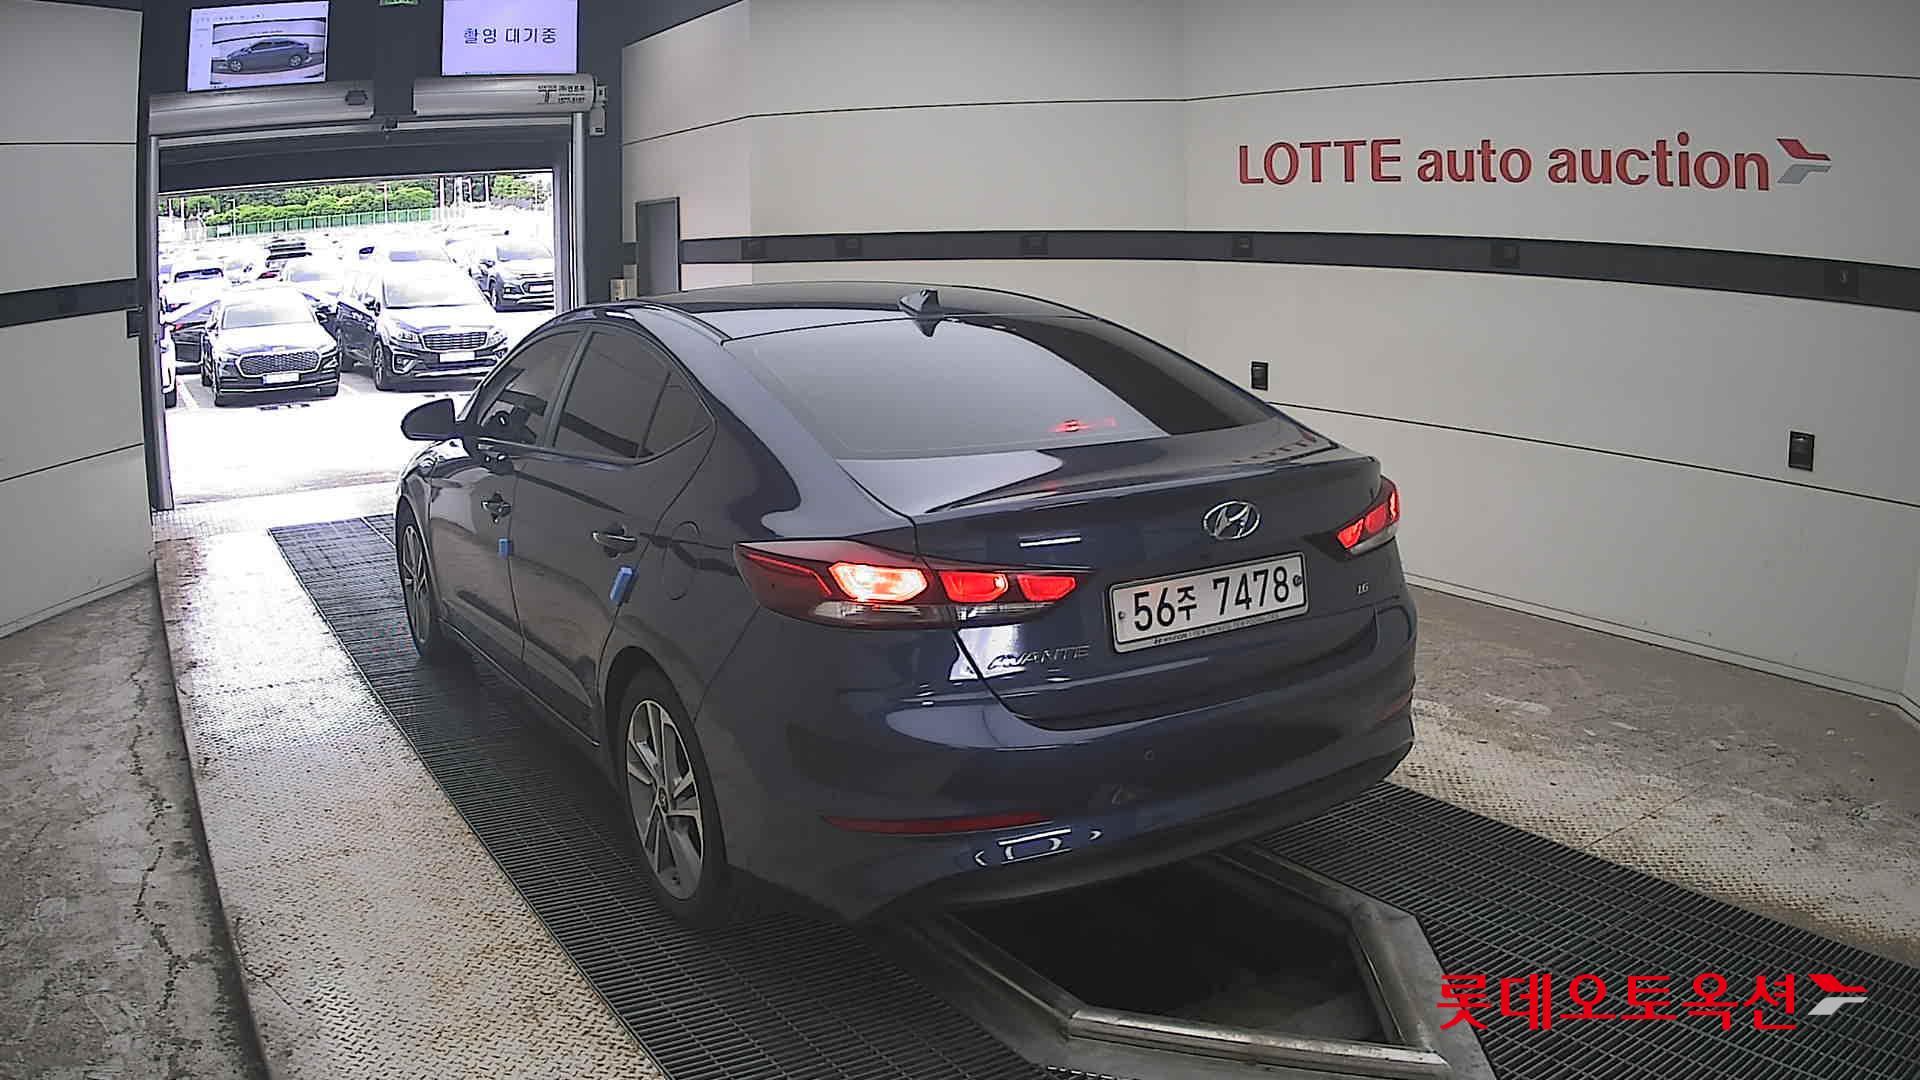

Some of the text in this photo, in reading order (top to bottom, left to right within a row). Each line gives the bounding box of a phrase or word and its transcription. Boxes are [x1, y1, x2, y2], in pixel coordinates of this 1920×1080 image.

[505, 28, 556, 44] 대기중
[1238, 131, 1770, 191] LOTTE auto auction
[1132, 586, 1198, 631] 56주
[1212, 566, 1290, 616] 7478
[987, 645, 1091, 670] AVANTE
